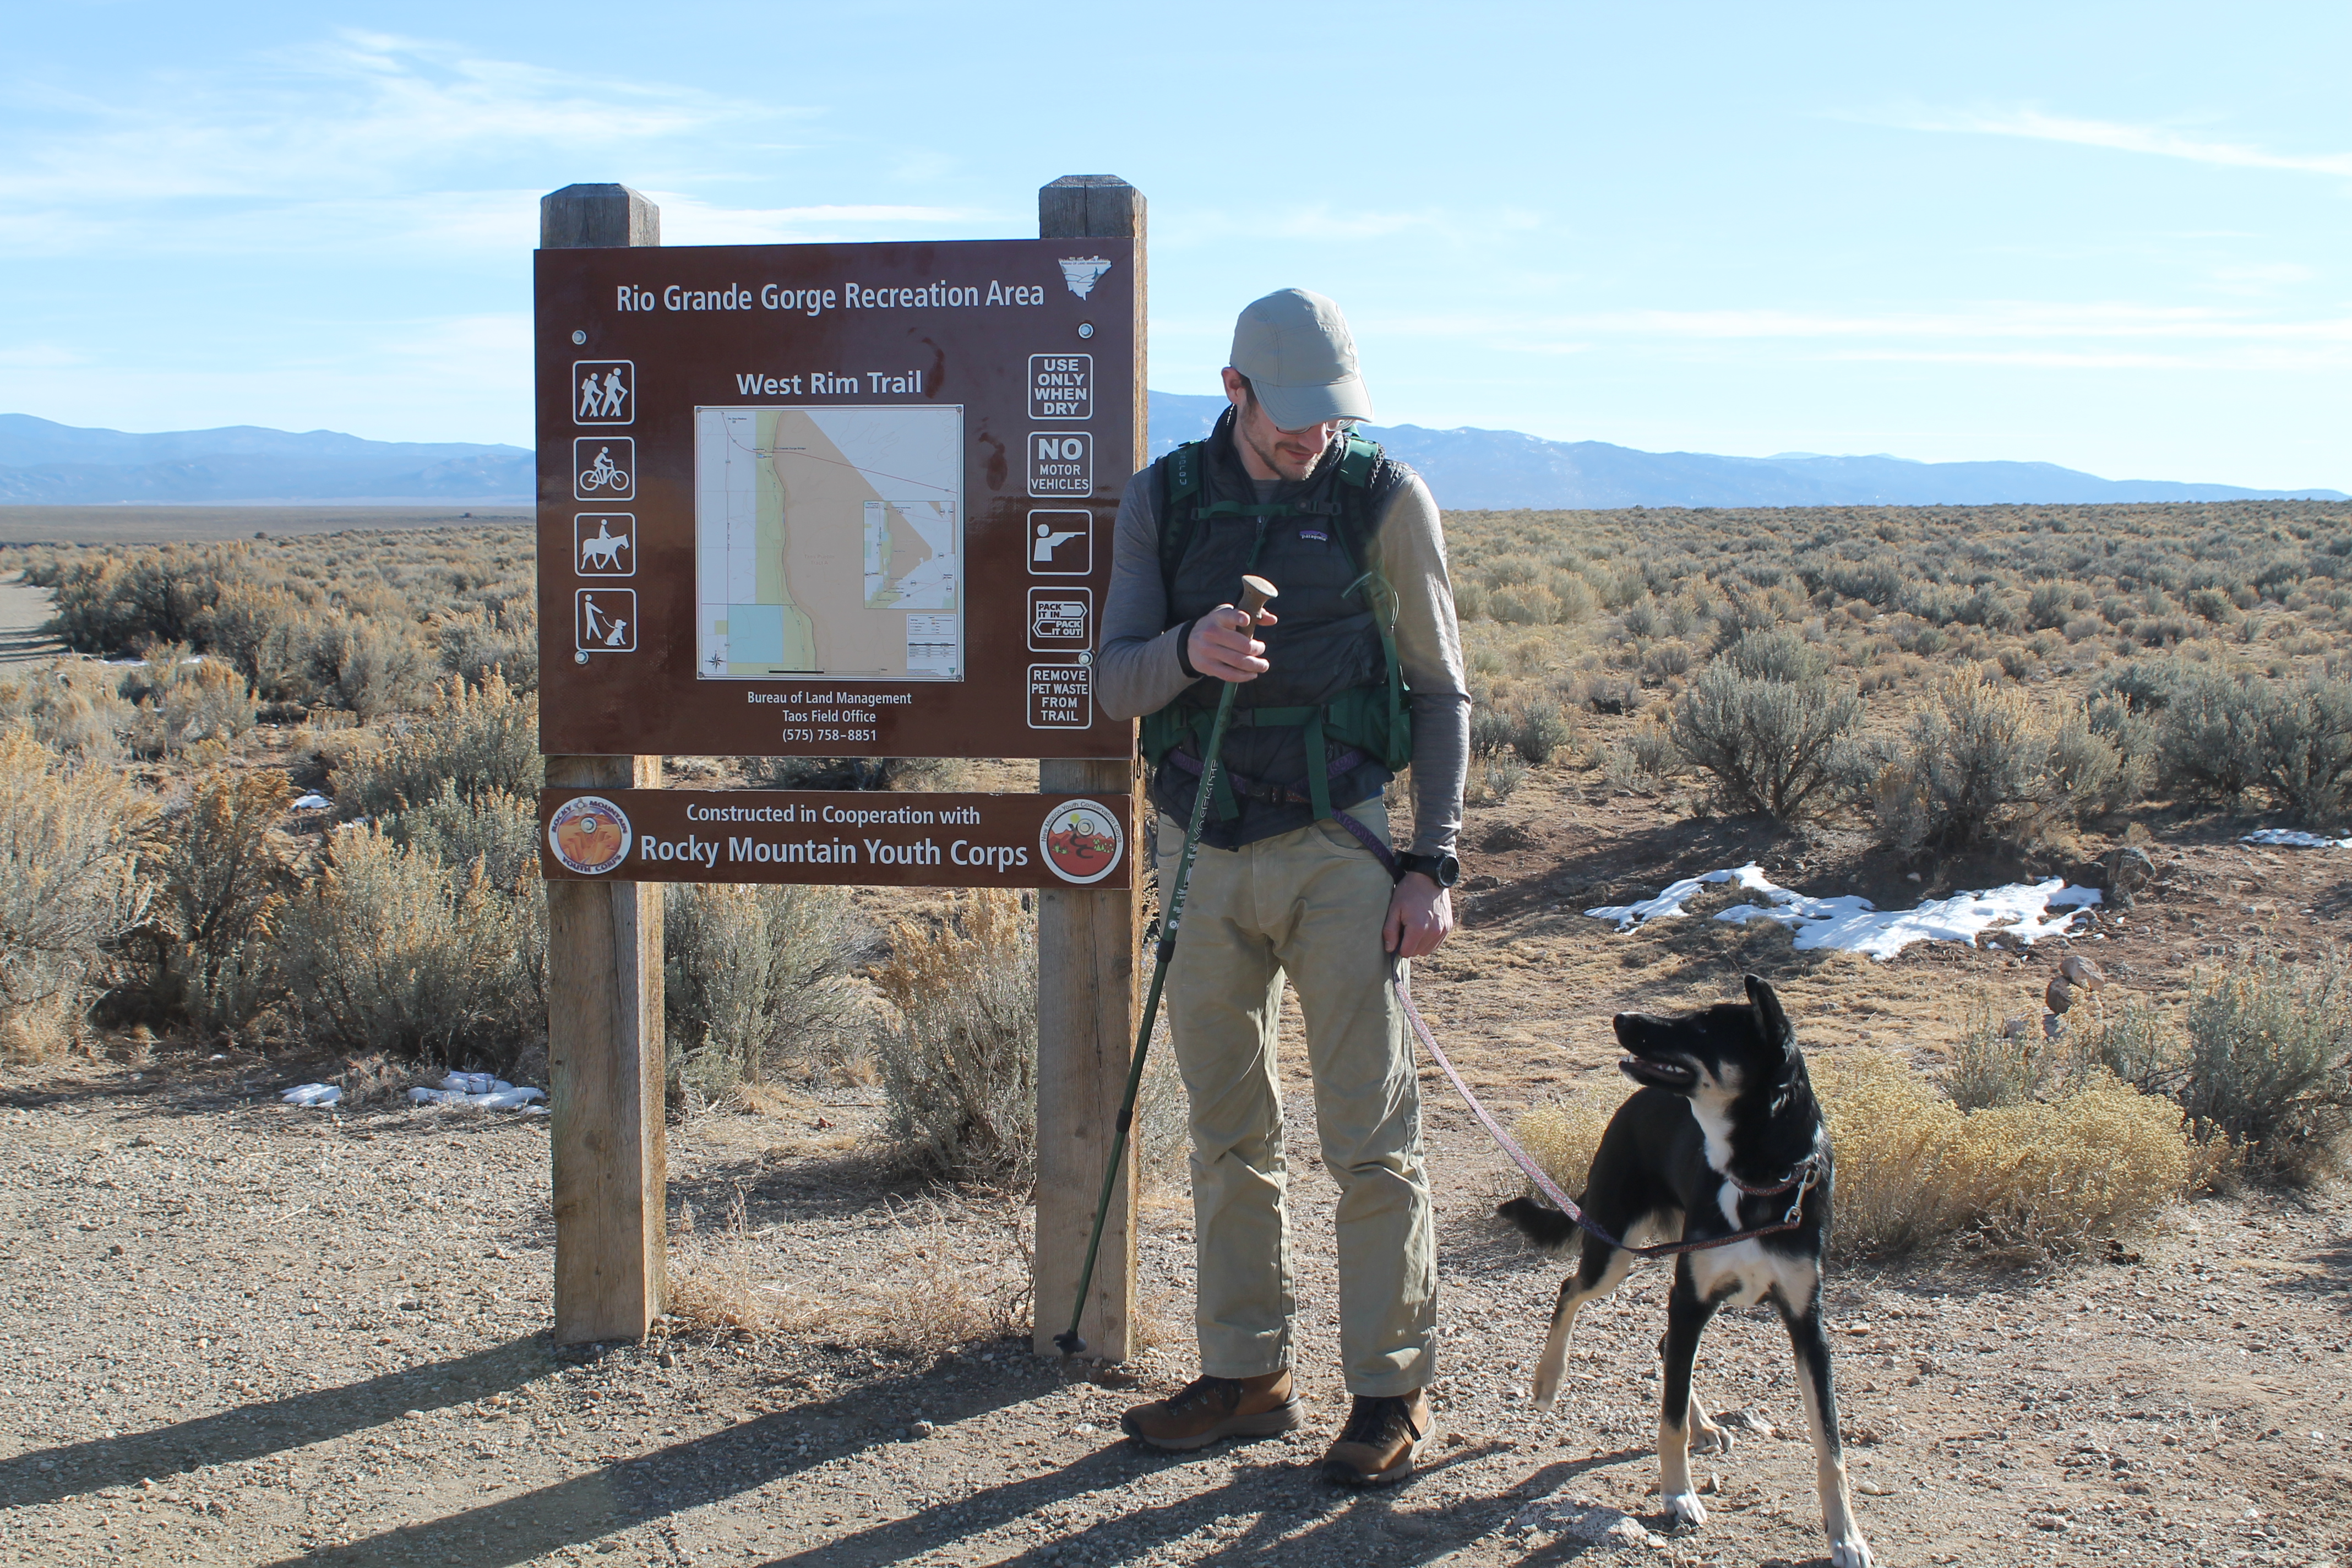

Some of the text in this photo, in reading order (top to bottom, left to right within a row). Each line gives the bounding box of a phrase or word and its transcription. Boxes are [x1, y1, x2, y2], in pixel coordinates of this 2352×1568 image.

[618, 280, 1043, 316] Rio Grande Gorge Recreation Area
[1044, 359, 1079, 371] USE
[736, 370, 921, 394] West Rim Trail
[1038, 374, 1085, 385] ONLY
[1035, 388, 1086, 400] WHEN
[1044, 402, 1079, 414] DRY
[1039, 438, 1082, 460] NO
[1040, 464, 1080, 475] MOTOR
[1031, 478, 1089, 490] VEHICLES
[1034, 670, 1086, 680] REMOVE
[1032, 684, 1088, 695] PET WASTE
[748, 691, 911, 706] Bureau of Land Management
[1042, 697, 1077, 707] FROM
[783, 710, 875, 722] Taos Field Office
[1041, 710, 1078, 721] TRAIL
[783, 729, 875, 743] (575) 758-8851
[552, 801, 628, 834] ROCKY MOUNTAIN
[687, 804, 979, 827] Constructed in Cooperation with
[1045, 809, 1061, 827] Mexico
[1061, 802, 1079, 811] Youth
[1080, 802, 1115, 824] Conservation
[1114, 825, 1122, 843] Corps
[641, 835, 1027, 873] Rocky Mountain Youth Corps
[562, 853, 622, 872] YOUTH CORPS
